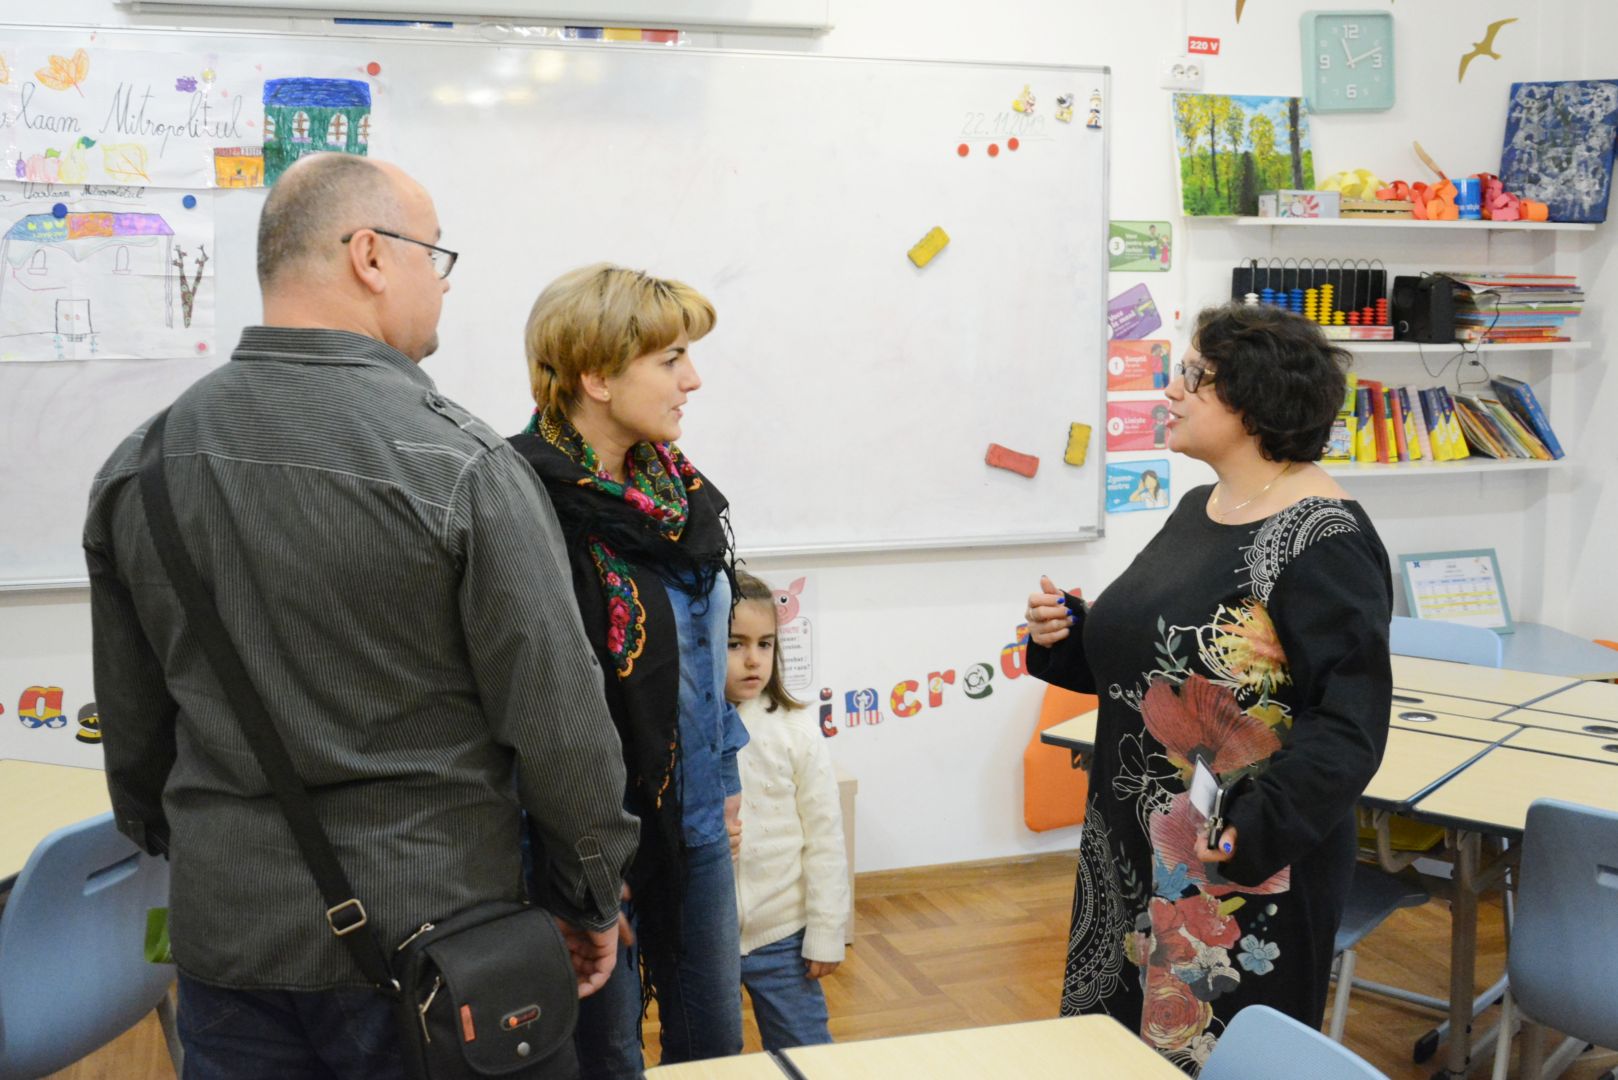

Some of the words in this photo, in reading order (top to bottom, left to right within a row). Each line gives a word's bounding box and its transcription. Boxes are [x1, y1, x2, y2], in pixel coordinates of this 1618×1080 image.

[1343, 24, 1359, 39] 12
[1190, 40, 1208, 50] 220
[1210, 41, 1218, 51] V
[1320, 54, 1330, 70] 9
[1371, 53, 1382, 69] 3
[1346, 84, 1357, 98] 6
[98, 82, 243, 159] Mitropolitul
[1114, 240, 1120, 251] 3
